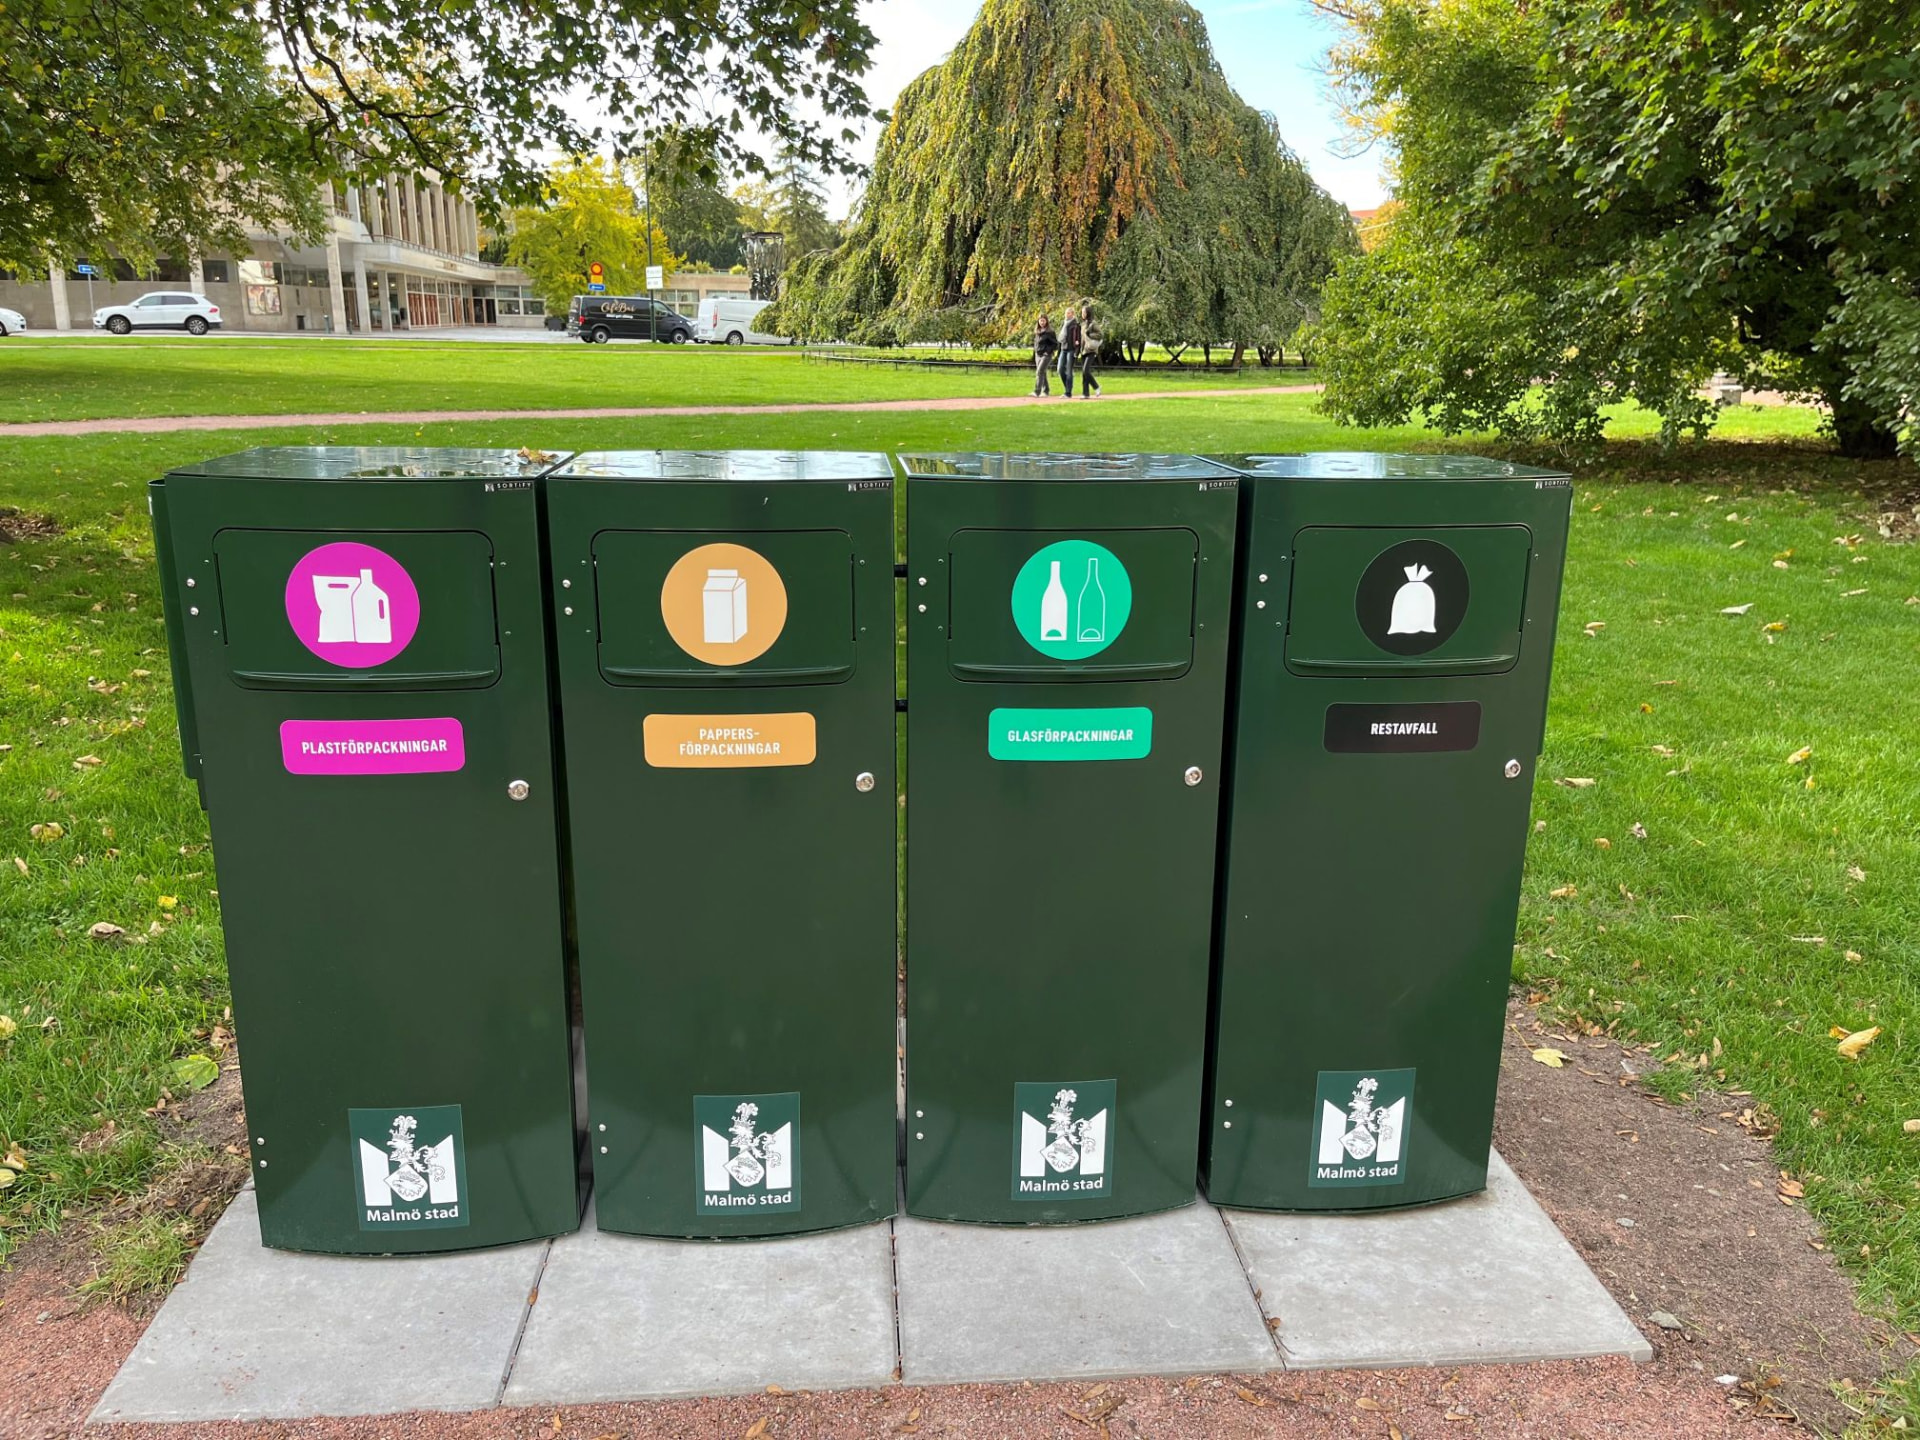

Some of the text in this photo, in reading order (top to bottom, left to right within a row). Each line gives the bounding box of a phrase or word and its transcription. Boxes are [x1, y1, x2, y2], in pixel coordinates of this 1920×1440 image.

[699, 728, 760, 741] PAPPERS-
[1007, 728, 1133, 743] GLASFÖRPACKNINGAR
[1370, 722, 1438, 735] RESTAVFALL
[301, 739, 447, 755] PLASTFÖRPACKNINGAR
[679, 741, 781, 756] FÖRPACKNINGAR
[1317, 1163, 1398, 1179] Malmö stad
[1020, 1176, 1103, 1192] Malmö stad
[704, 1191, 792, 1206] Malmö stad
[366, 1205, 459, 1222] Malmö stad
